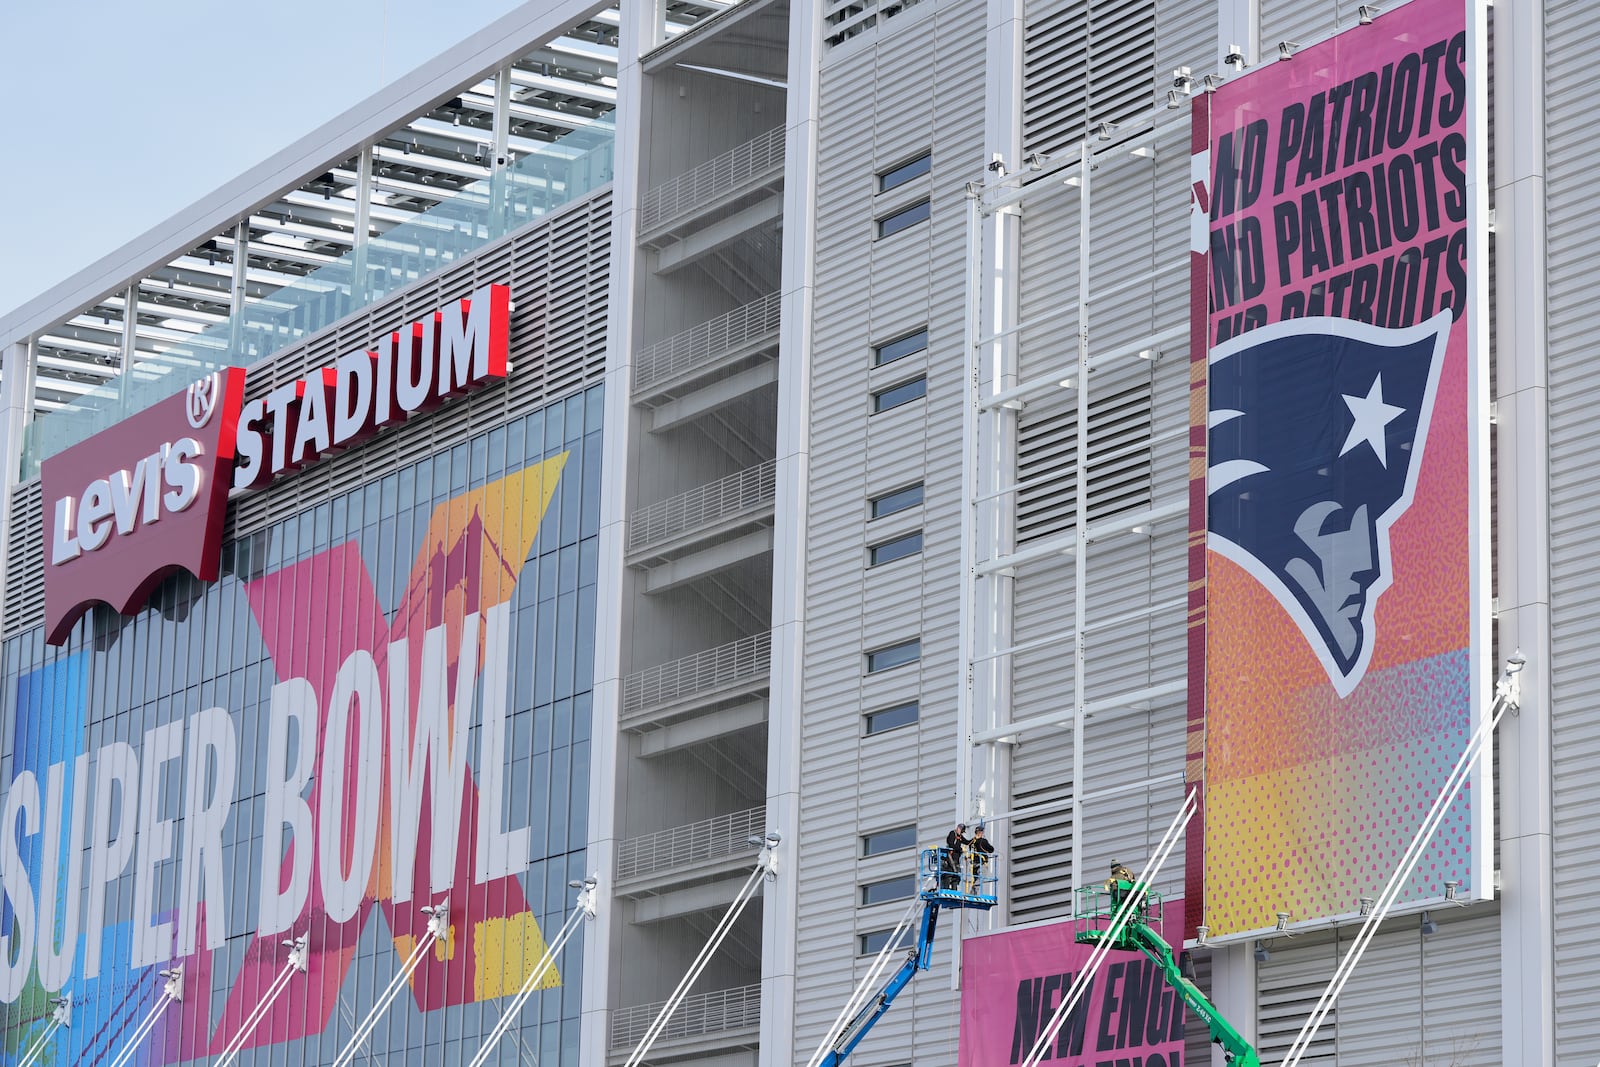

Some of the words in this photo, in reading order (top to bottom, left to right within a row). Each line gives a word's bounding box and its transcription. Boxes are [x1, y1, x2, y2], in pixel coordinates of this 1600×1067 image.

[1211, 118, 1268, 222] ND
[1273, 30, 1466, 197] PATRIOTS
[1209, 215, 1265, 315] ND
[1273, 132, 1466, 287] PATRIOTS
[234, 284, 497, 488] STADIUM
[0, 706, 237, 1002] SUPER
[258, 601, 531, 938] BOWL
[1010, 968, 1096, 1065] NEW
